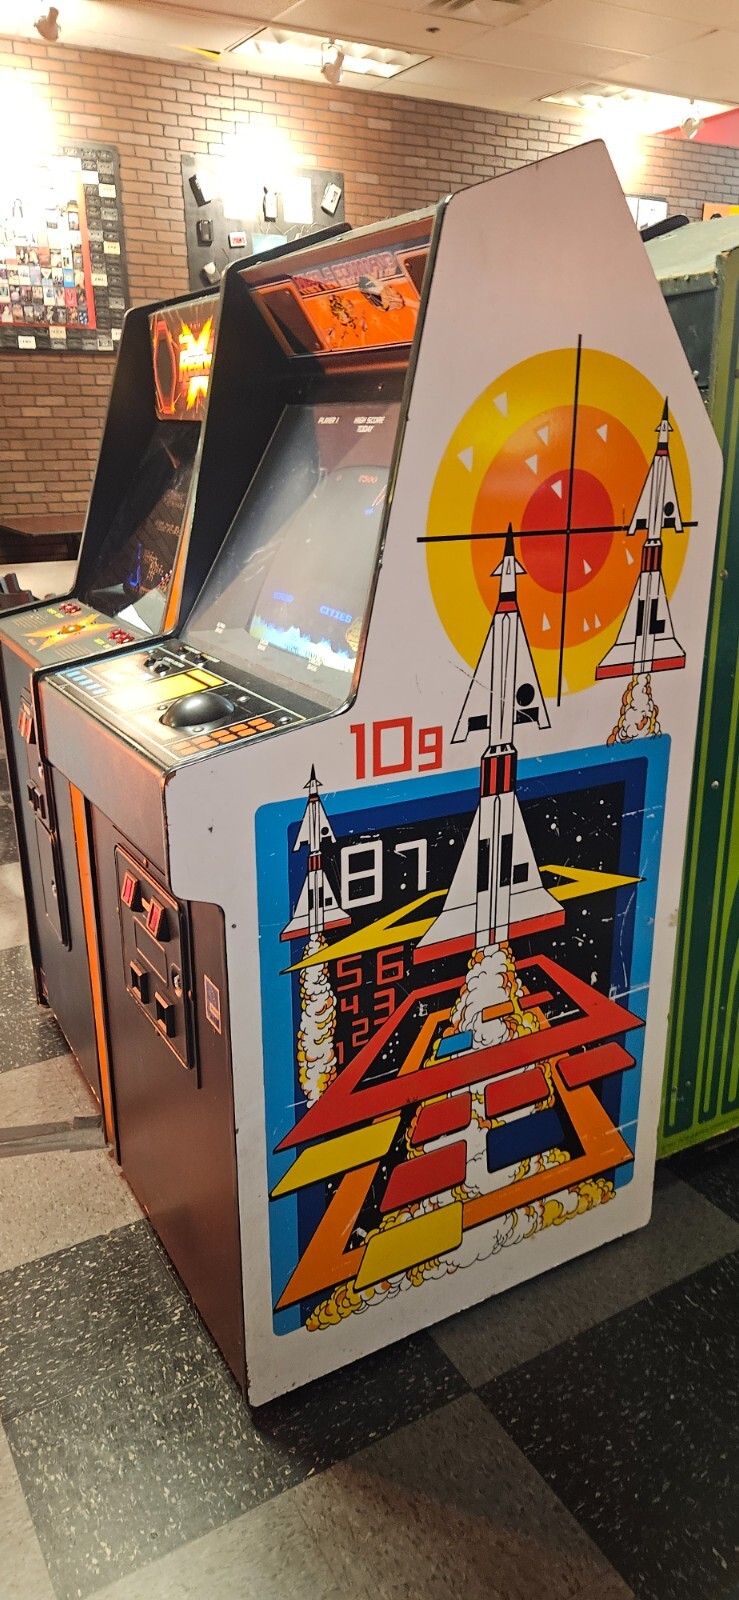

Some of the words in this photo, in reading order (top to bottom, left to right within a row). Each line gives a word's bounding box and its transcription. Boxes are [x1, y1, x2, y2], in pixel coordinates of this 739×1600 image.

[317, 416, 336, 425] PLAYER
[353, 416, 367, 425] HIGH
[366, 416, 386, 425] SCORE
[356, 425, 375, 433] TODAY
[319, 604, 353, 623] CITIES
